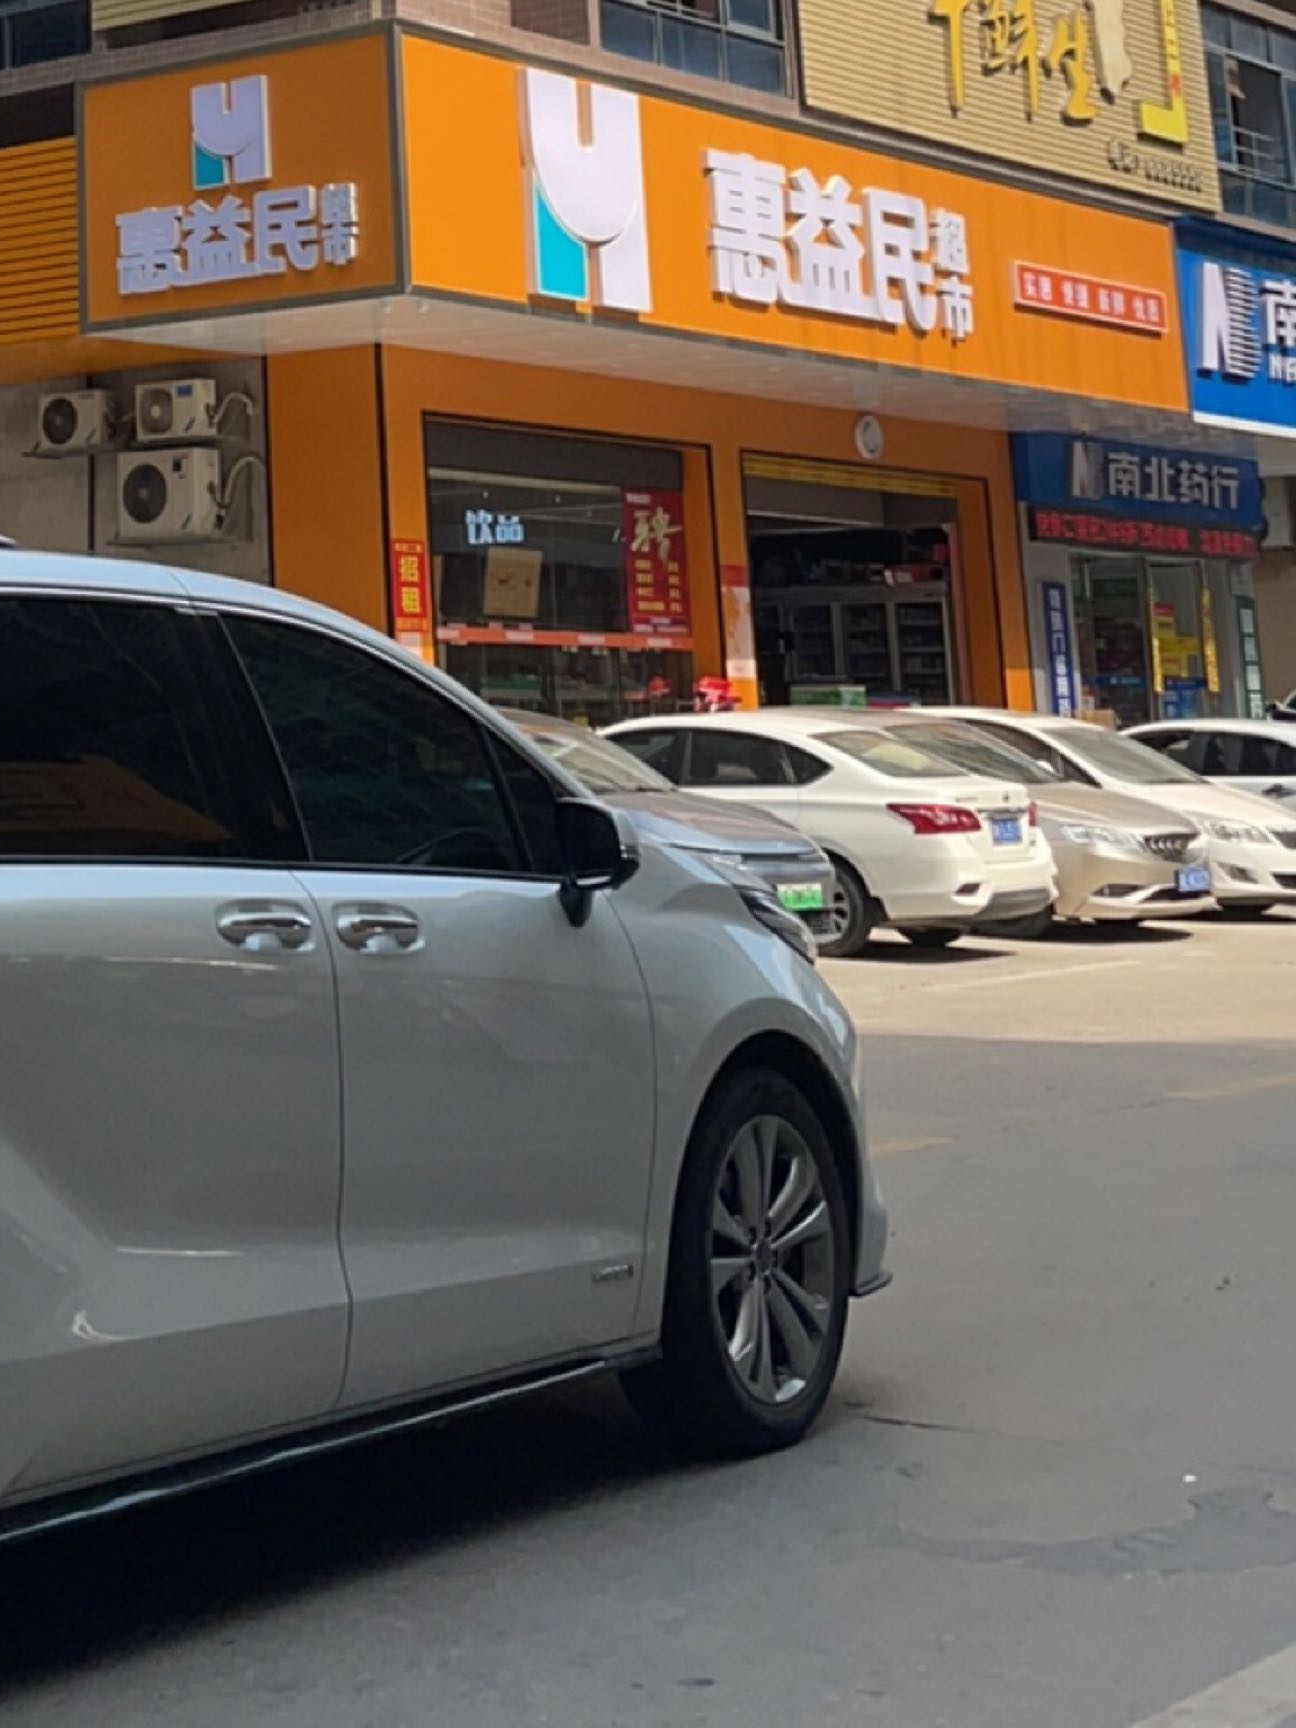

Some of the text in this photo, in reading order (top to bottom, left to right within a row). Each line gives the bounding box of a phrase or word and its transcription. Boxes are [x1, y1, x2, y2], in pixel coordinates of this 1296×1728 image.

[1108, 451, 1240, 511] 南北药行
[399, 554, 421, 614] 招租
